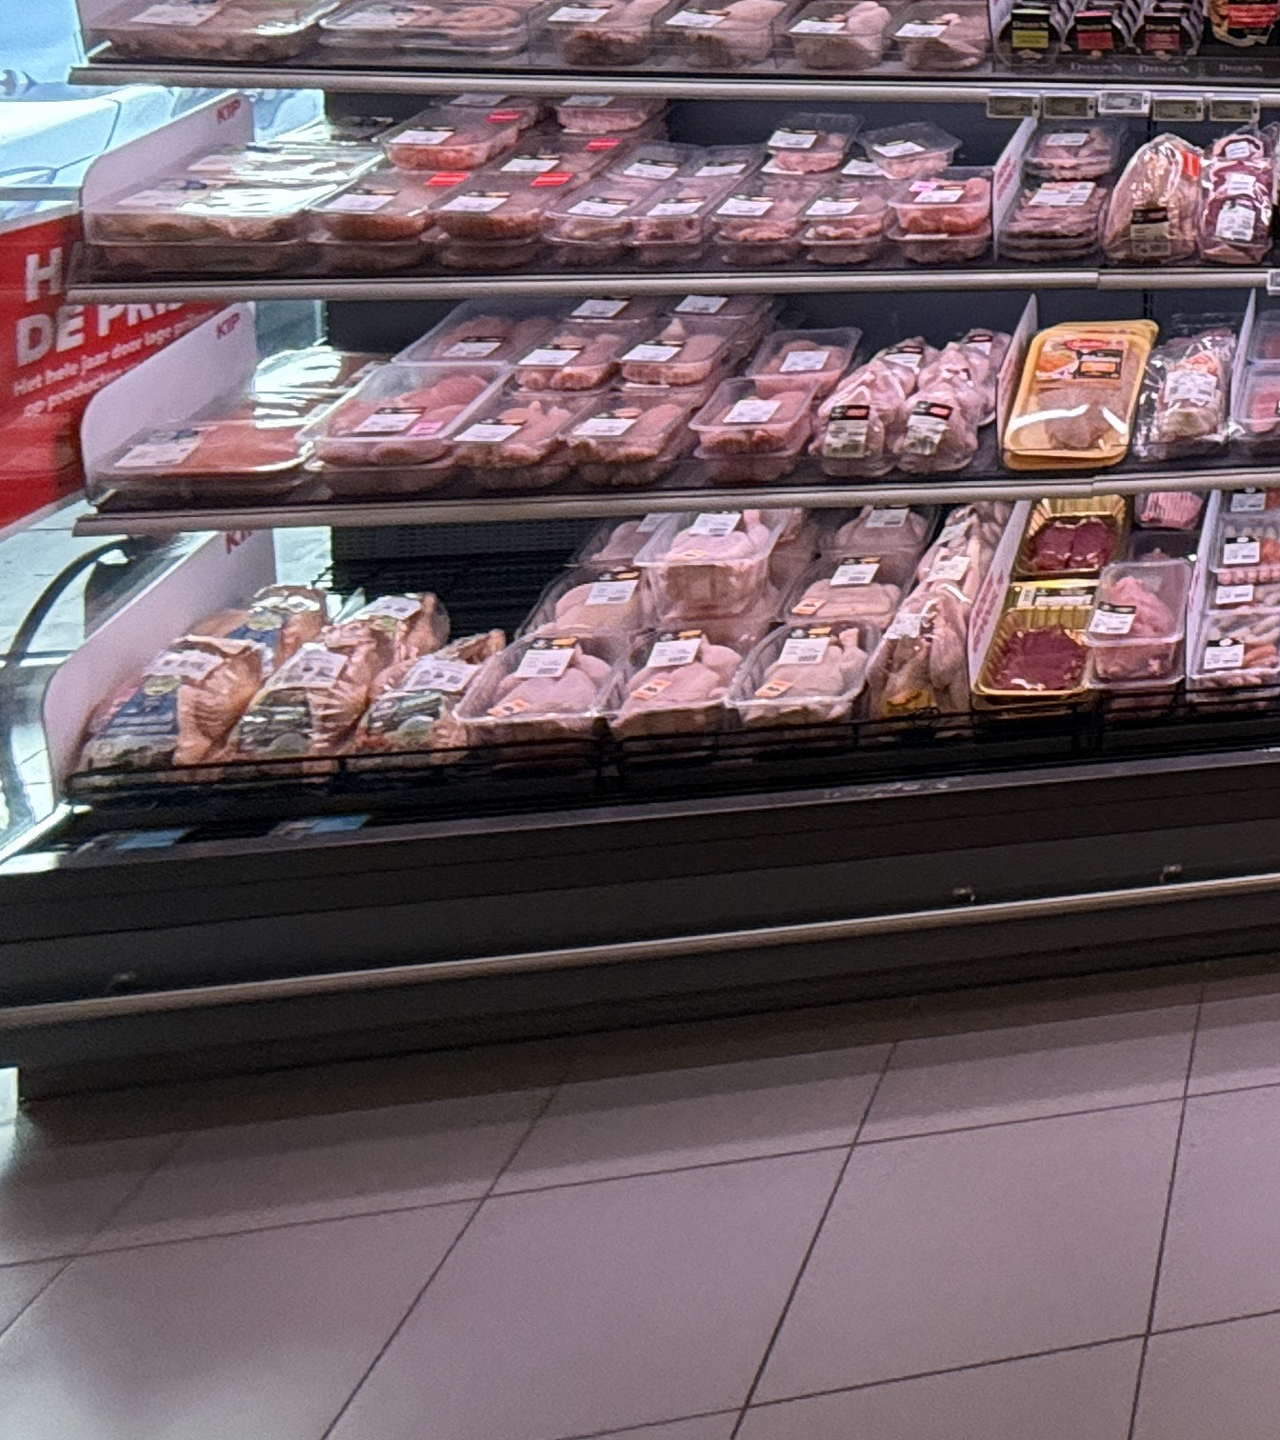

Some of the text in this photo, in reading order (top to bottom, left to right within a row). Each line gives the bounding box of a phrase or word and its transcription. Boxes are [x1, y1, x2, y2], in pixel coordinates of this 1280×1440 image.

[216, 99, 241, 124] KIP
[16, 304, 85, 368] DE
[216, 312, 241, 340] KIP
[14, 374, 43, 397] Het
